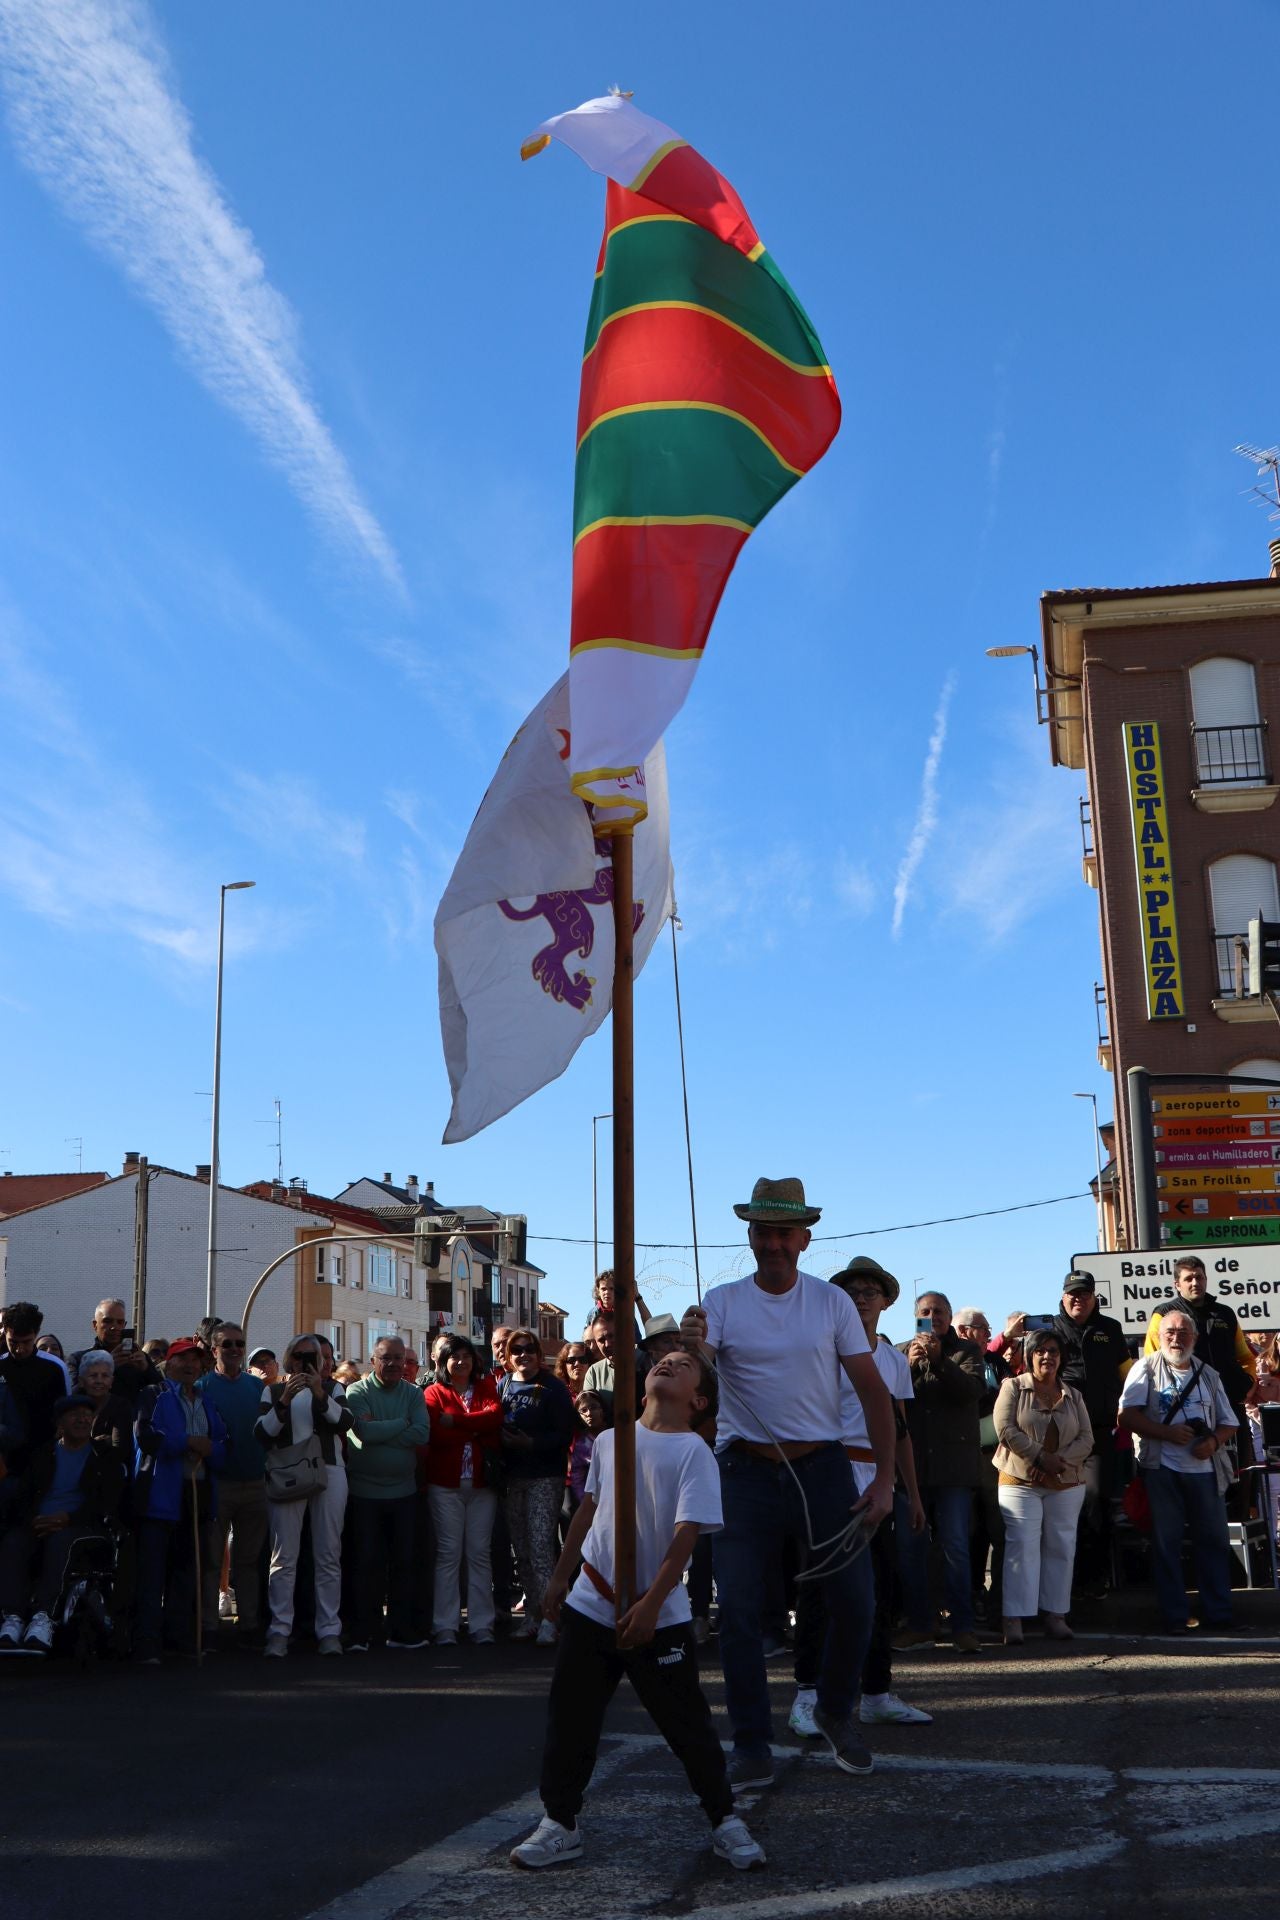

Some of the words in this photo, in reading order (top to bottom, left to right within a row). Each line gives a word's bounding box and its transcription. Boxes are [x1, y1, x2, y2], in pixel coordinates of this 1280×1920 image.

[1130, 725, 1164, 868] HOSTAL
[1145, 890, 1180, 1015] PLAZA
[1166, 1099, 1240, 1110] aeropuerto
[1168, 1128, 1191, 1136] zona
[1196, 1124, 1246, 1136] deportiva
[1169, 1153, 1194, 1161] ermita
[1197, 1152, 1209, 1160] del
[1212, 1149, 1269, 1160] Humilladero
[1172, 1176, 1197, 1186] San
[1203, 1174, 1251, 1185] Froilán
[1206, 1223, 1268, 1238] ASPRONA
[1121, 1259, 1177, 1277] Basíl
[1214, 1257, 1239, 1273] de
[1123, 1284, 1174, 1300] Nues
[1124, 1307, 1147, 1323] La
[1237, 1301, 1270, 1318] del
[657, 1652, 682, 1665] PUMA
